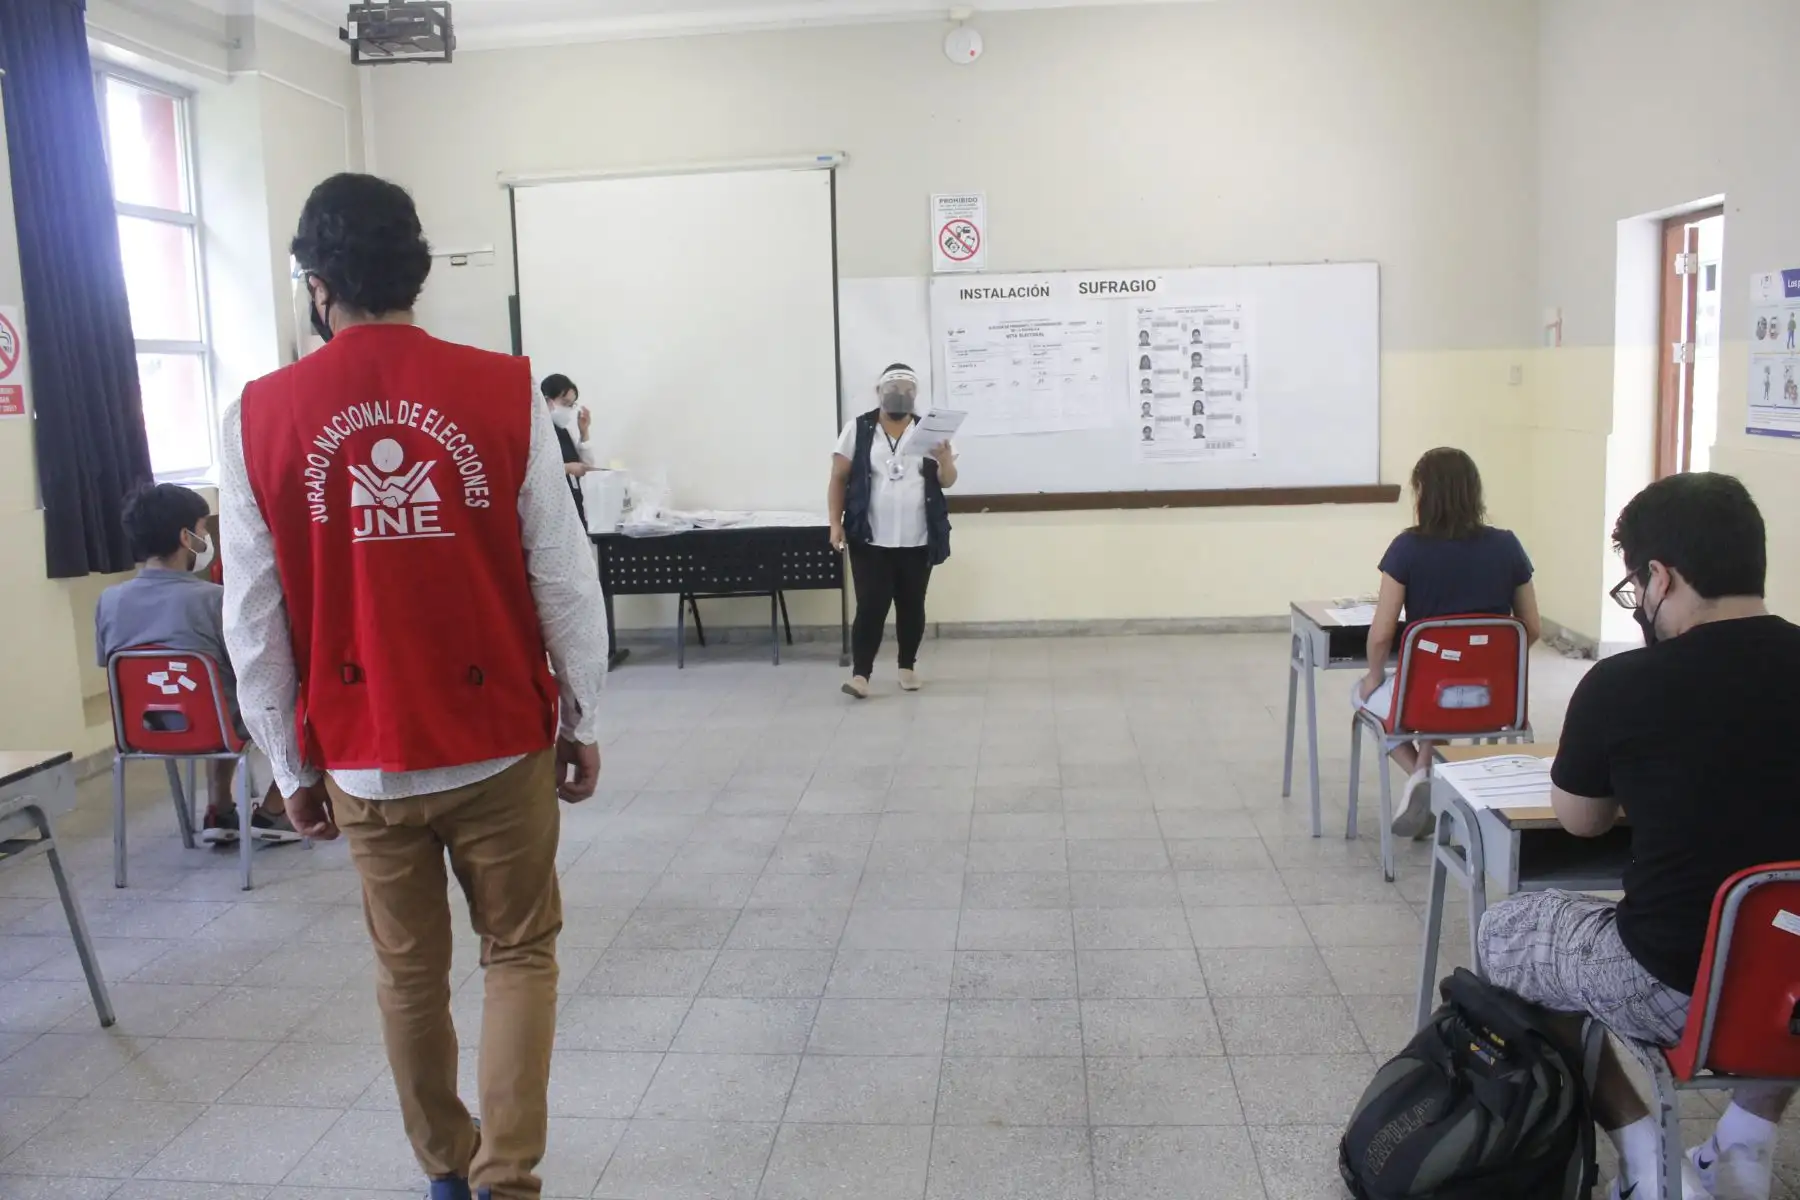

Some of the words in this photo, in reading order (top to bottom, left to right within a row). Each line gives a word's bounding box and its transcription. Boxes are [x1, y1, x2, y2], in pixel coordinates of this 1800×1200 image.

[960, 283, 1050, 300] INSTALACIÓN
[1078, 279, 1157, 295] SUFRAGIO
[312, 399, 394, 455] NACIONAL
[397, 399, 423, 428] DE
[420, 408, 490, 508] ELECCIONES
[304, 453, 330, 523] JURADO
[353, 505, 442, 537] JNE
